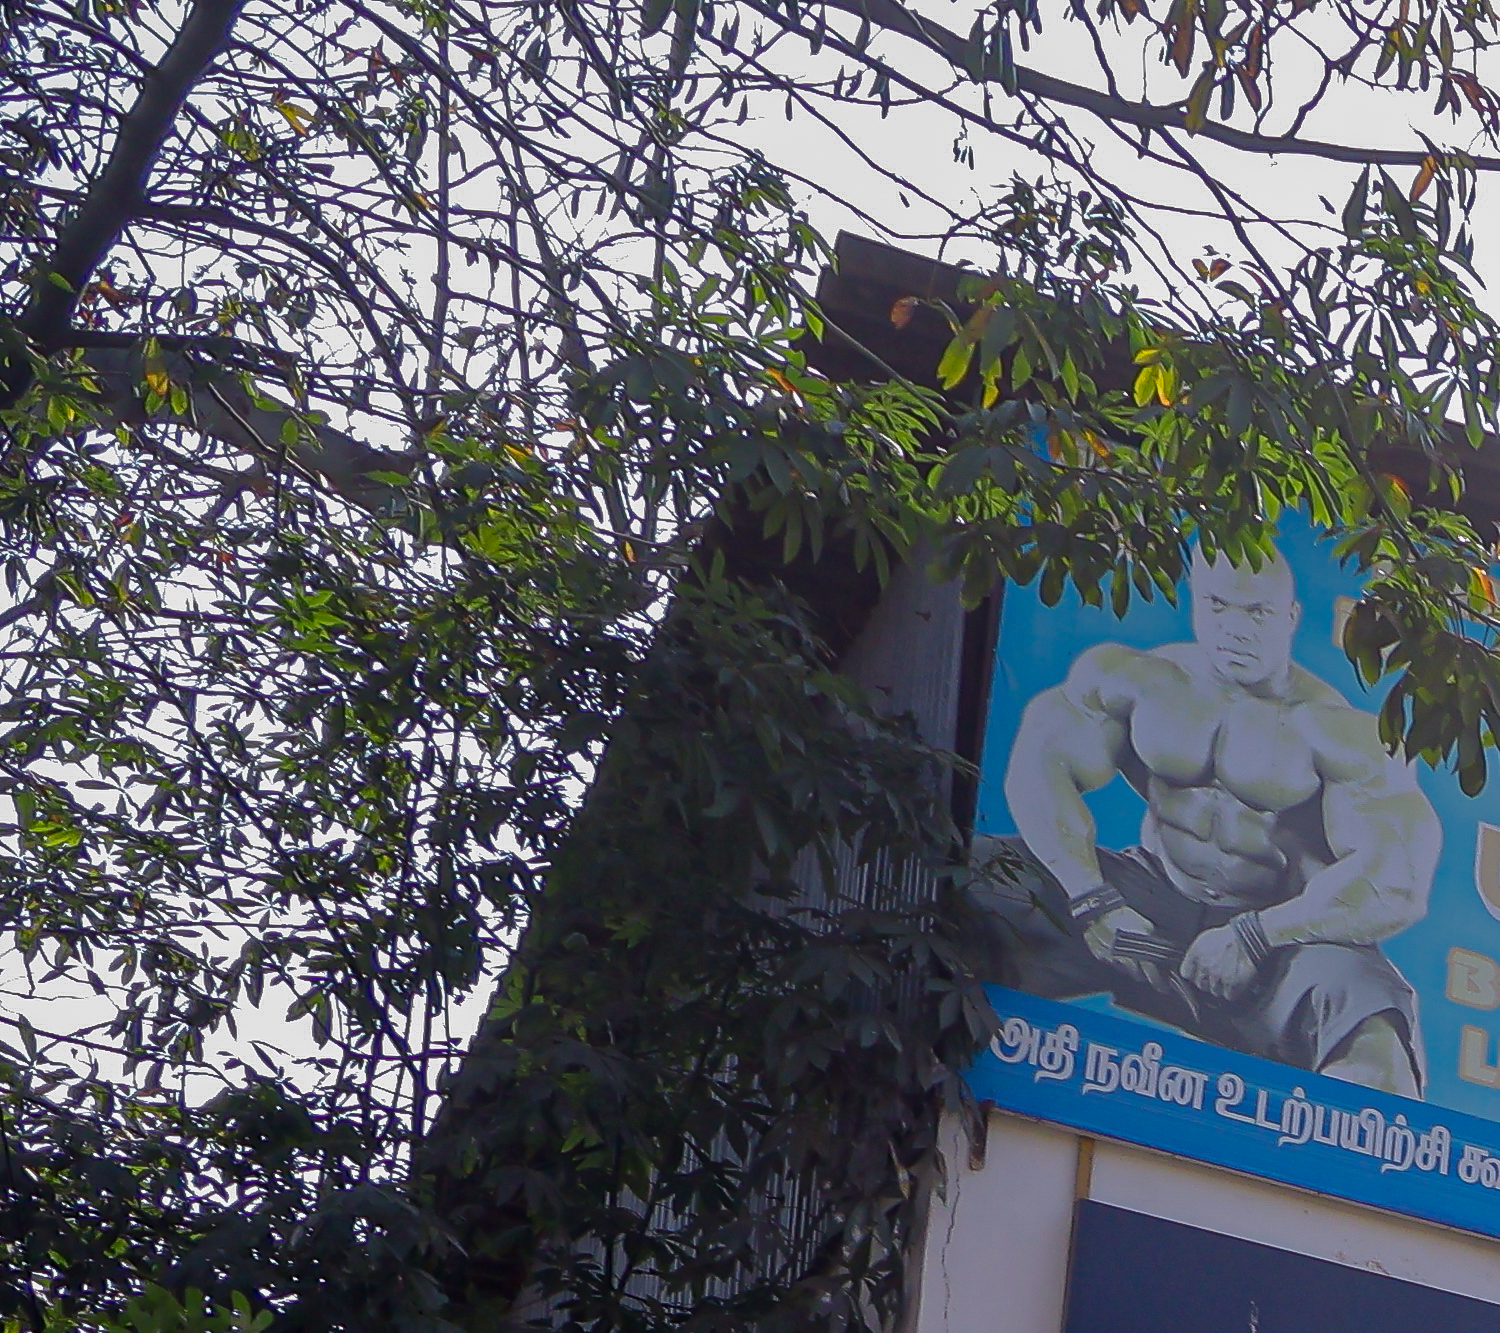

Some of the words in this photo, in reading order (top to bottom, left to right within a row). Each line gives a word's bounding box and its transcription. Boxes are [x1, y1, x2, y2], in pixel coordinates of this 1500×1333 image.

[990, 1016, 1079, 1082] அதி
[1082, 1043, 1208, 1110] நவீன
[1214, 1072, 1451, 1175] உடற்பயிற்சி
